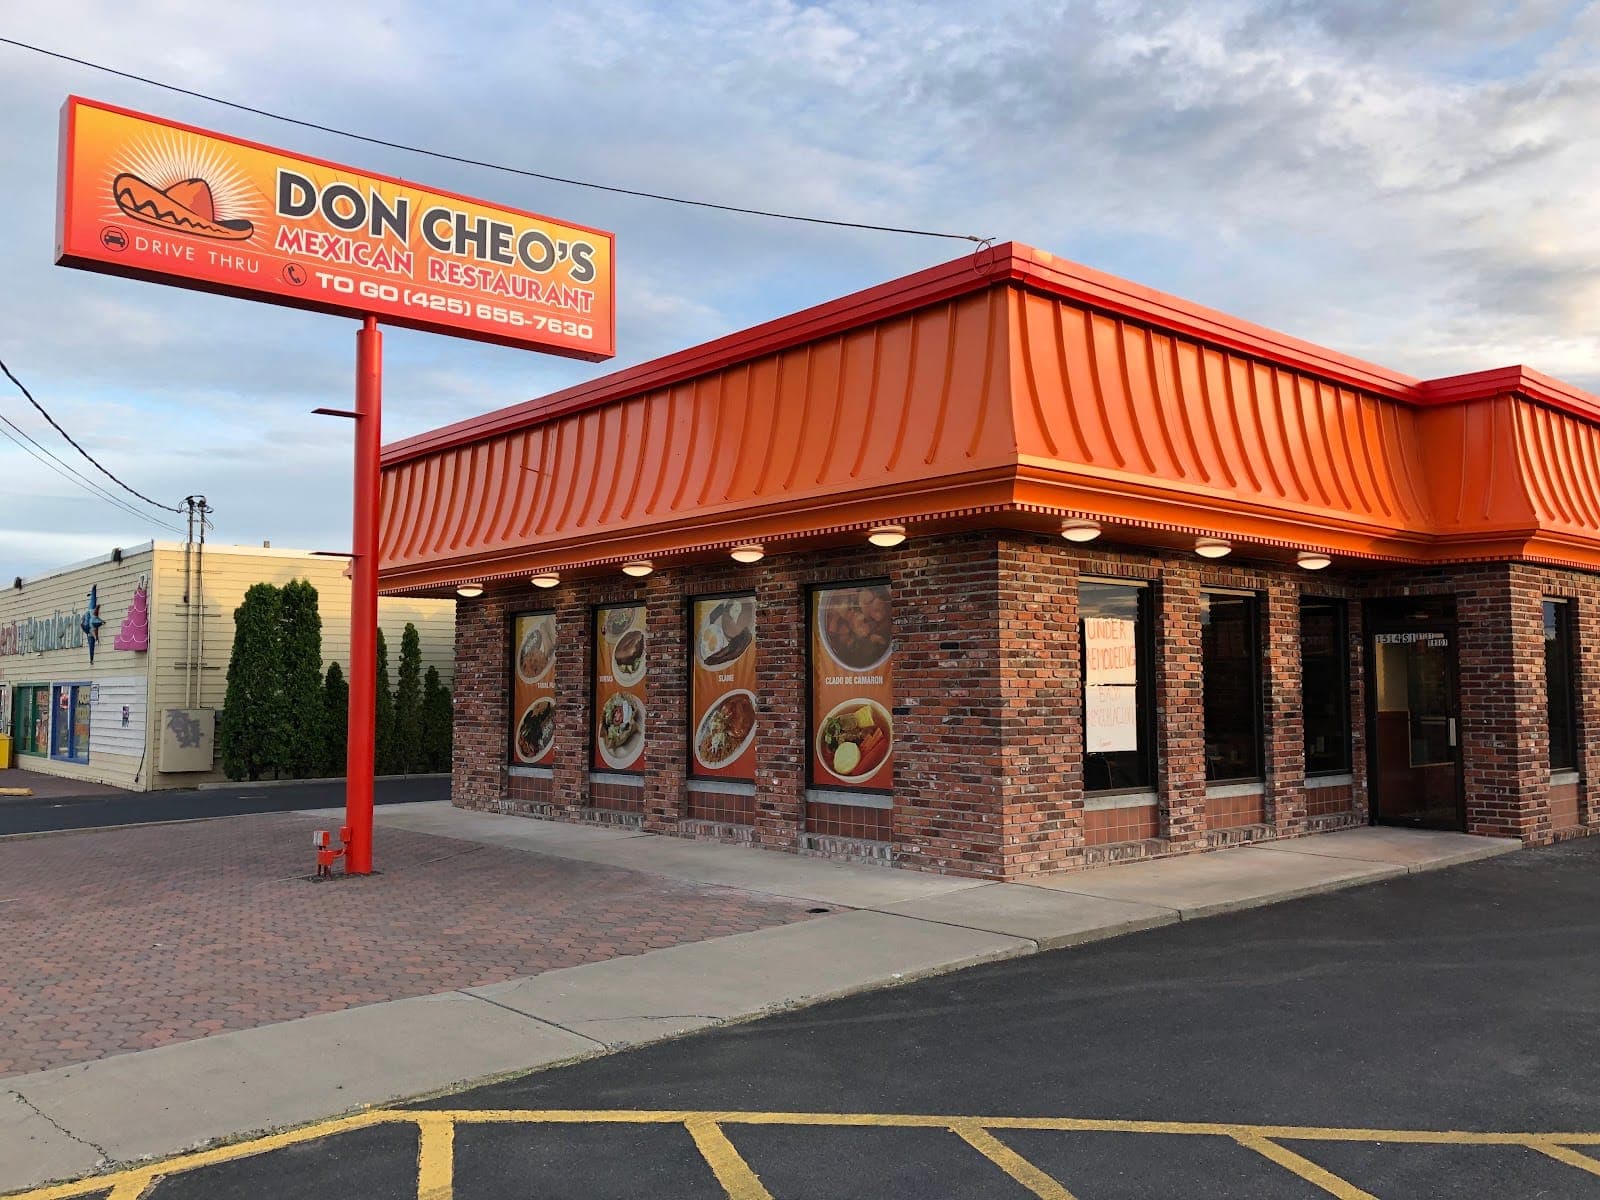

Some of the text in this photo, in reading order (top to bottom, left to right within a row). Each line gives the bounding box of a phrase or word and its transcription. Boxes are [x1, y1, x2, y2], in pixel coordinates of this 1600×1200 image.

[276, 168, 596, 284] DON CHEO'S
[135, 237, 259, 273] DRIVE THRU
[275, 226, 594, 313] MEXICAN RESTAURANT
[316, 272, 593, 339] TO GO (425) 655-7630
[1087, 620, 1127, 640] UNDER
[844, 676, 853, 685] DE
